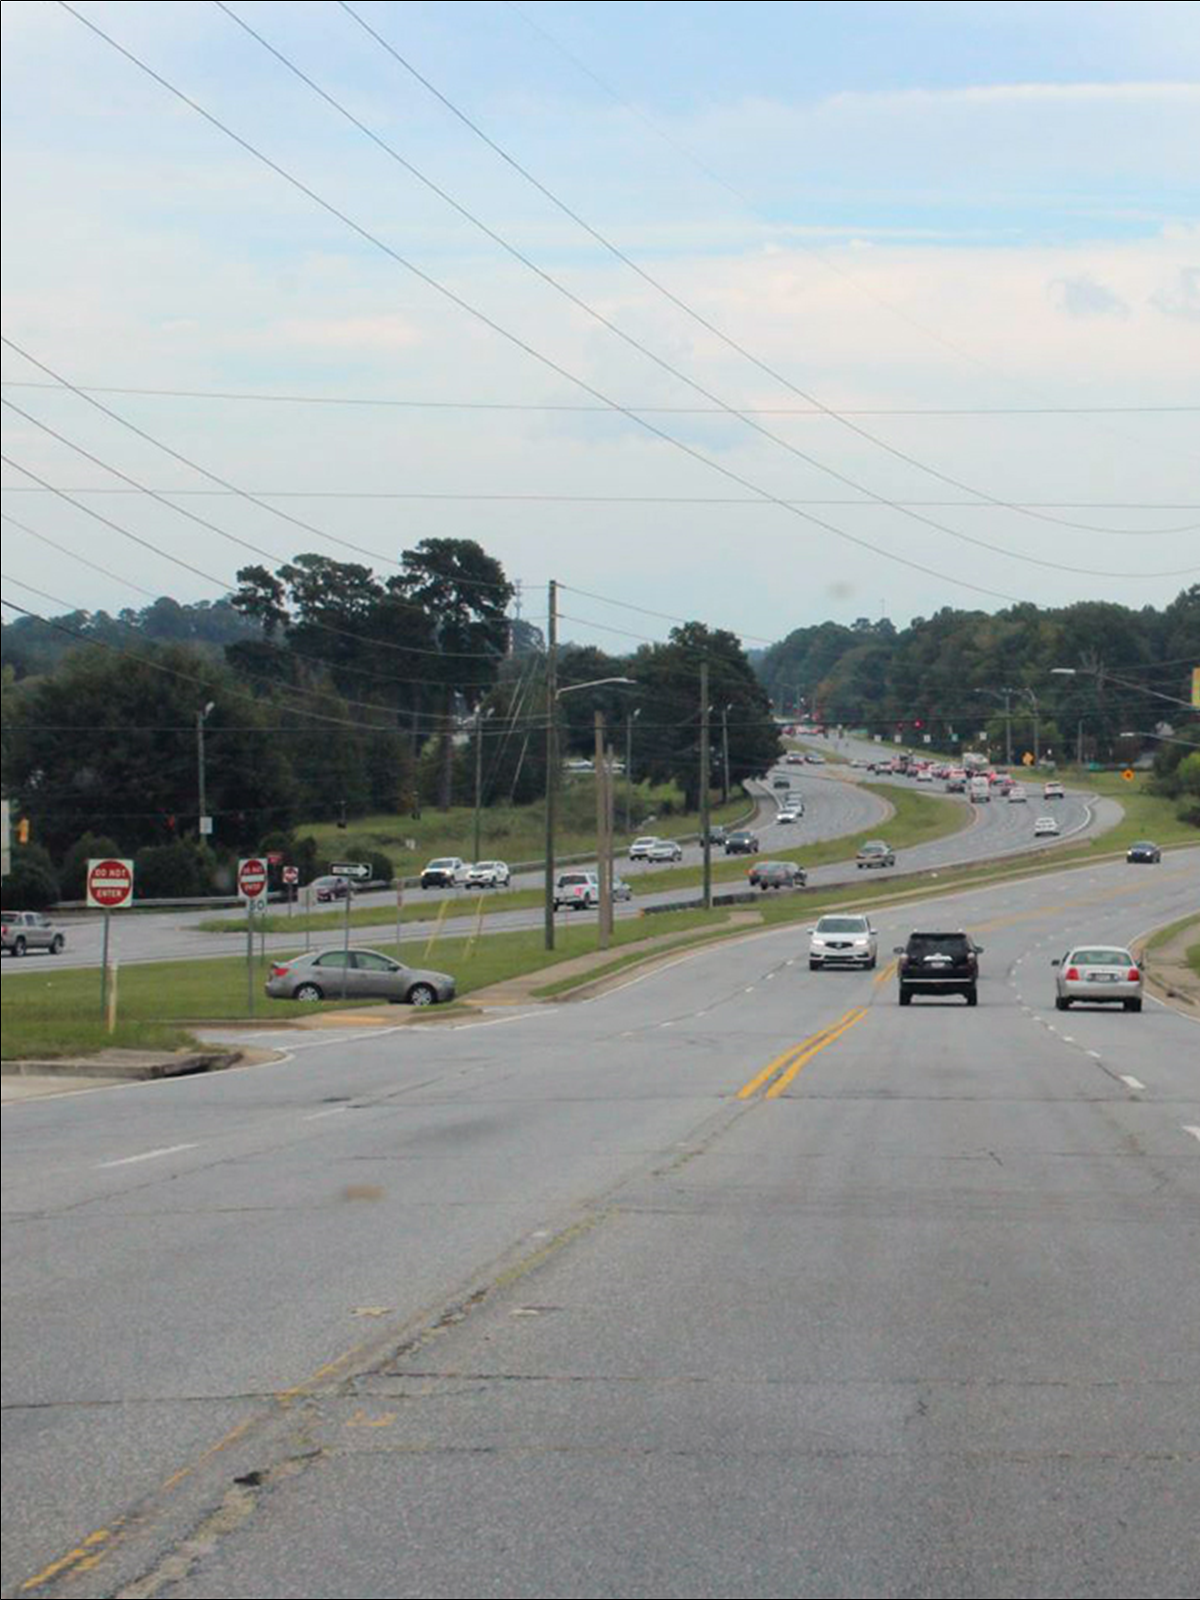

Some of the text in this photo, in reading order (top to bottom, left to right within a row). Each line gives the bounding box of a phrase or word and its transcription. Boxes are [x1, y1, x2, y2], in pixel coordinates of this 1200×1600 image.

[94, 868, 126, 877] DO NOT
[96, 889, 122, 898] ENTER
